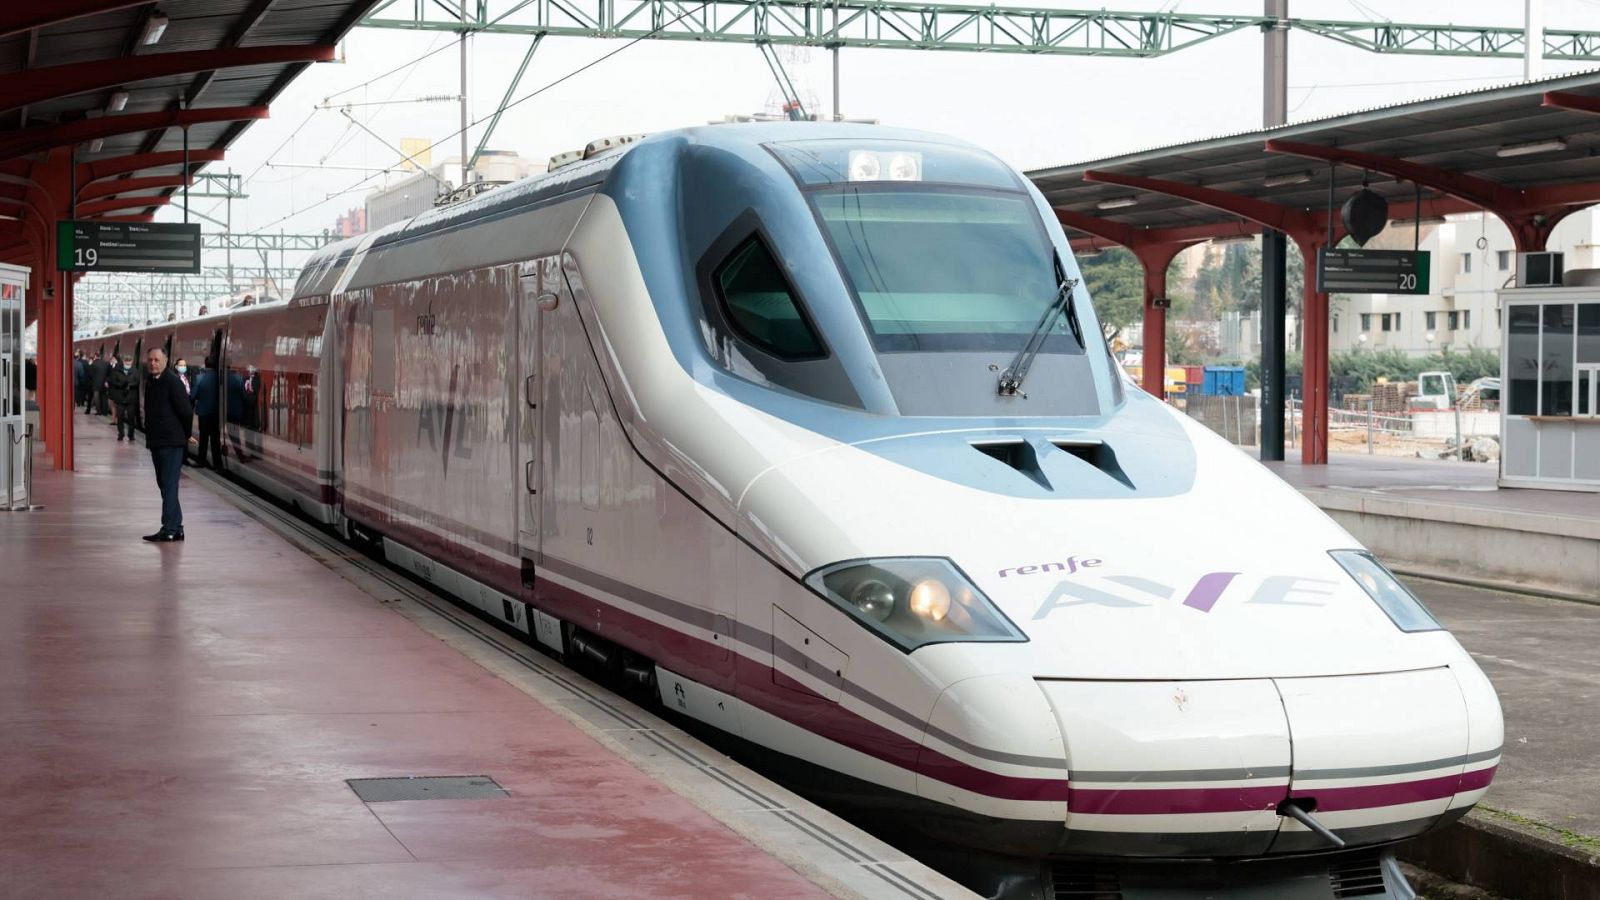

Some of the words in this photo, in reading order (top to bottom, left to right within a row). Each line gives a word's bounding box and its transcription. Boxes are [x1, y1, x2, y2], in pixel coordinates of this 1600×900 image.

[75, 248, 98, 266] 19
[1399, 274, 1416, 290] 20
[998, 555, 1103, 578] renfe
[1031, 571, 1341, 621] AVE
